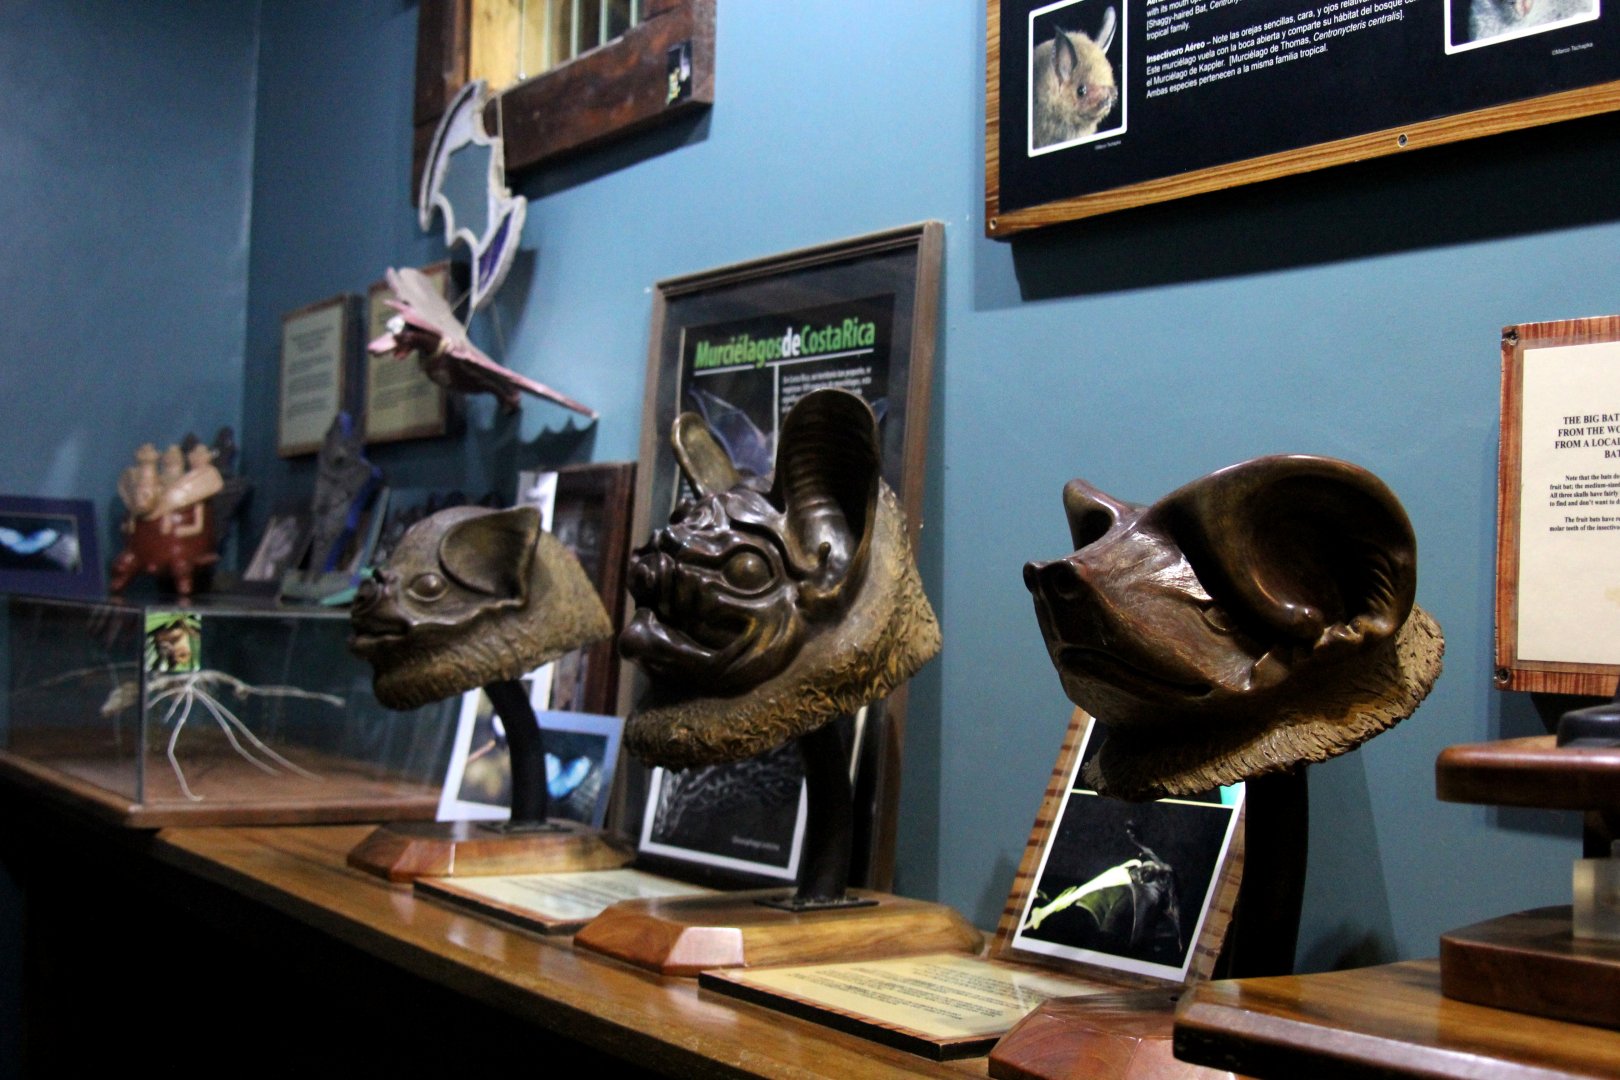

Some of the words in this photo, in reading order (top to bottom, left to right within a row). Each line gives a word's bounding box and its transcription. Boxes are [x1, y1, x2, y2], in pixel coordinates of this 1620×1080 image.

[1146, 65, 1160, 76] Este
[1161, 55, 1196, 70] murciélago
[1198, 50, 1215, 61] vuela
[1216, 47, 1229, 56] con
[1230, 42, 1237, 52] la
[1238, 39, 1255, 50] boca
[1256, 31, 1280, 44] abierta
[1282, 30, 1287, 40] y
[1288, 21, 1321, 36] comparte
[1322, 18, 1332, 27] su
[1334, 10, 1359, 24] hábitat
[1360, 4, 1372, 16] del
[1147, 48, 1183, 64] Insectivoro
[1212, 34, 1228, 45] Note
[1230, 31, 1240, 40] las
[1241, 24, 1262, 37] orejas
[1317, 8, 1322, 17] y
[1323, 2, 1339, 14] ojos
[1147, 27, 1169, 40] tropical
[1146, 78, 1153, 87] el
[1153, 69, 1188, 84] Murciélago
[1189, 66, 1197, 76] de
[1199, 60, 1225, 73] Kappler.
[1269, 44, 1279, 54] de
[1313, 20, 1367, 41] Centronycteris
[1146, 88, 1168, 99] Ambas
[1169, 79, 1197, 93] especies
[1199, 70, 1236, 86] pertenecen
[1243, 63, 1250, 73] la
[1250, 58, 1274, 70] misma
[1275, 51, 1299, 64] familia
[1300, 43, 1328, 58] tropical.
[1558, 428, 1584, 437] FROM
[1586, 426, 1604, 435] THE
[1563, 416, 1581, 425] THE
[1583, 414, 1600, 424] BIG
[1555, 440, 1581, 449] FROM
[1583, 439, 1589, 447] A
